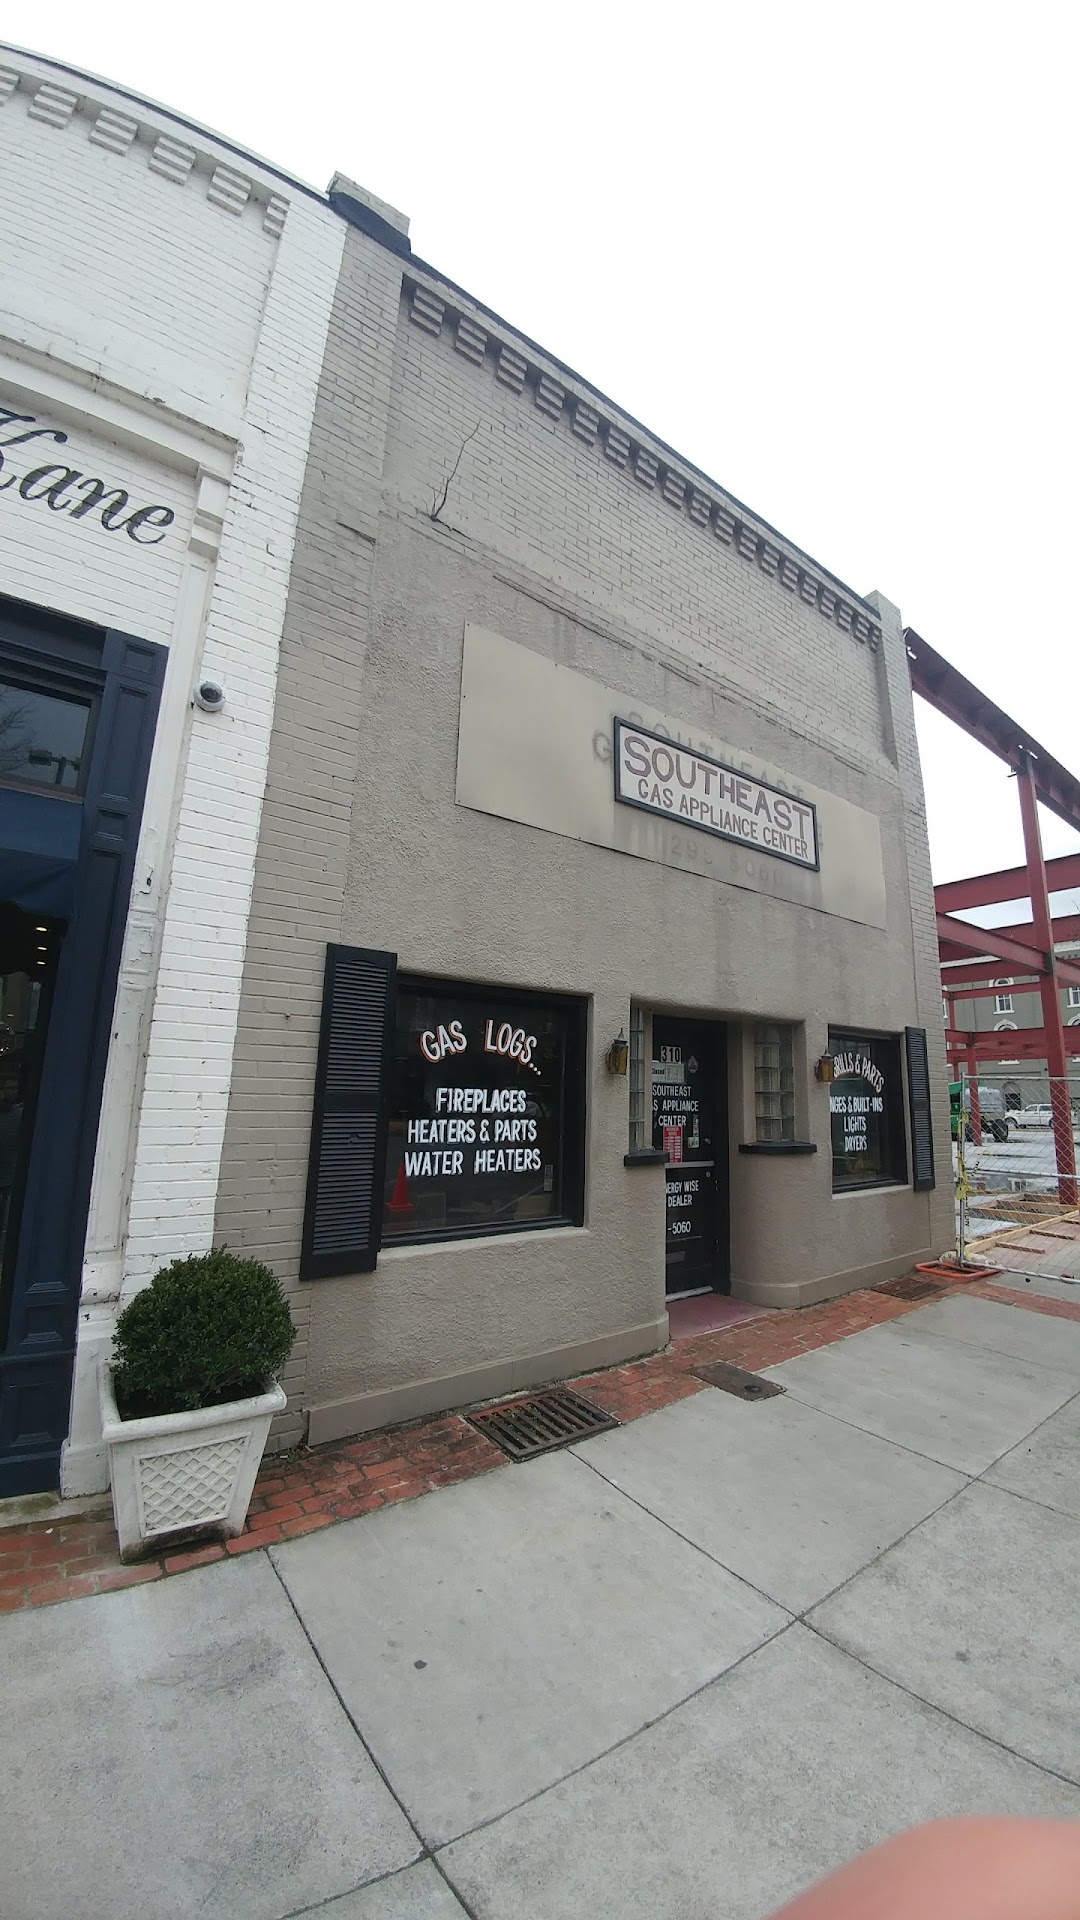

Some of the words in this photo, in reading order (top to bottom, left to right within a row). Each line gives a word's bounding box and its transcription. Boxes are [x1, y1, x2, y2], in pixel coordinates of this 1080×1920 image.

[624, 735, 810, 840] SOUTHEAST
[638, 778, 674, 809] GAS
[679, 794, 759, 841] APPLIANCE
[763, 826, 809, 859] CENTER
[420, 1020, 467, 1063] GAS
[661, 1046, 681, 1062] 310
[861, 1056, 884, 1093] PARTS
[652, 1085, 691, 1097] SOUTHEAST
[436, 1087, 526, 1113] FIREPLACES
[662, 1099, 699, 1112] APPLIANCE
[853, 1096, 883, 1112] BUILT-INS
[658, 1114, 687, 1126] CENTER
[843, 1115, 867, 1133] LIGHTS
[407, 1119, 476, 1144] HEATERS
[479, 1119, 490, 1143] &
[494, 1119, 537, 1143] PARTS
[844, 1135, 867, 1152] DRYERS
[404, 1151, 464, 1177] WATER
[474, 1148, 542, 1174] HEATERS
[684, 1180, 699, 1192] WISE
[667, 1194, 692, 1207] DEALER
